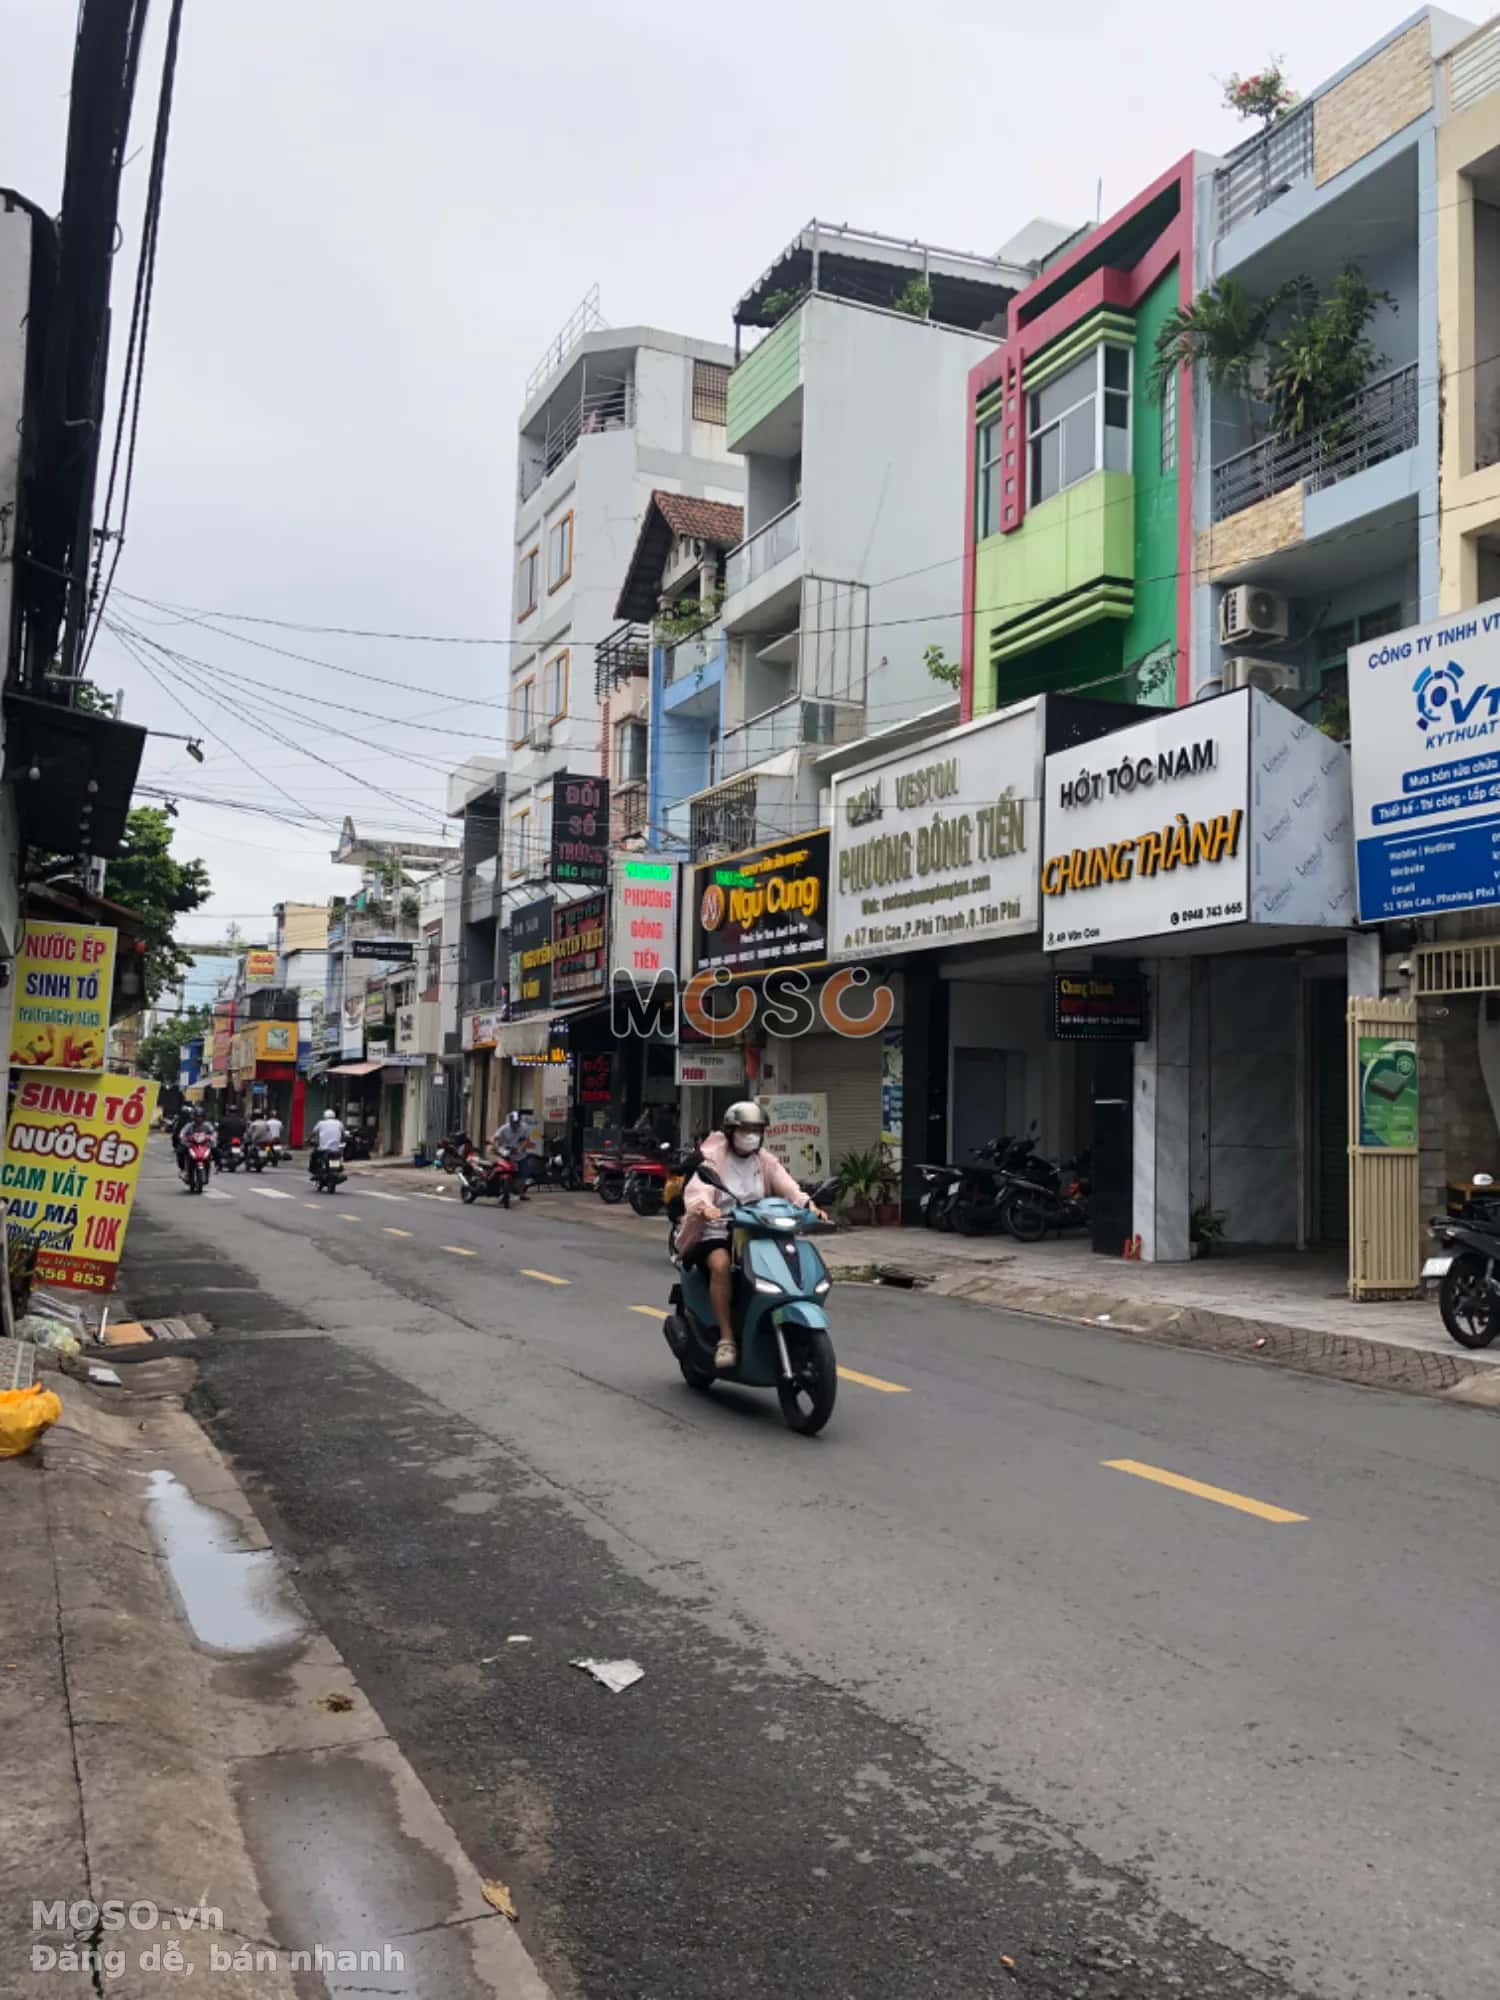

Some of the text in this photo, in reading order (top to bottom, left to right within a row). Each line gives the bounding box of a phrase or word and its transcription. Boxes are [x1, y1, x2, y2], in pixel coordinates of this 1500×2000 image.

[1368, 645, 1412, 670] CÔNG
[1416, 635, 1433, 653] TY
[1437, 620, 1477, 647] TNHH
[1060, 739, 1215, 808] HỚT TÓC NAM
[1409, 776, 1429, 787] Mua
[1431, 768, 1450, 782] bán
[1436, 794, 1461, 810] công
[839, 830, 913, 895] PHƯƠNG
[1041, 842, 1136, 895] CHUNG
[1135, 809, 1243, 877] THÀNH
[1424, 842, 1456, 856] Hotline
[766, 876, 819, 917] Cung
[81, 936, 106, 964] ÉP
[26, 968, 102, 1000] SINH TỐ
[21, 1082, 146, 1126] SINH TỐ
[11, 1123, 138, 1168] NƯỚC ÉP
[1, 1164, 130, 1205] CAM VẮT 15K
[44, 1204, 78, 1225] MÁ
[84, 1215, 122, 1252] 10K
